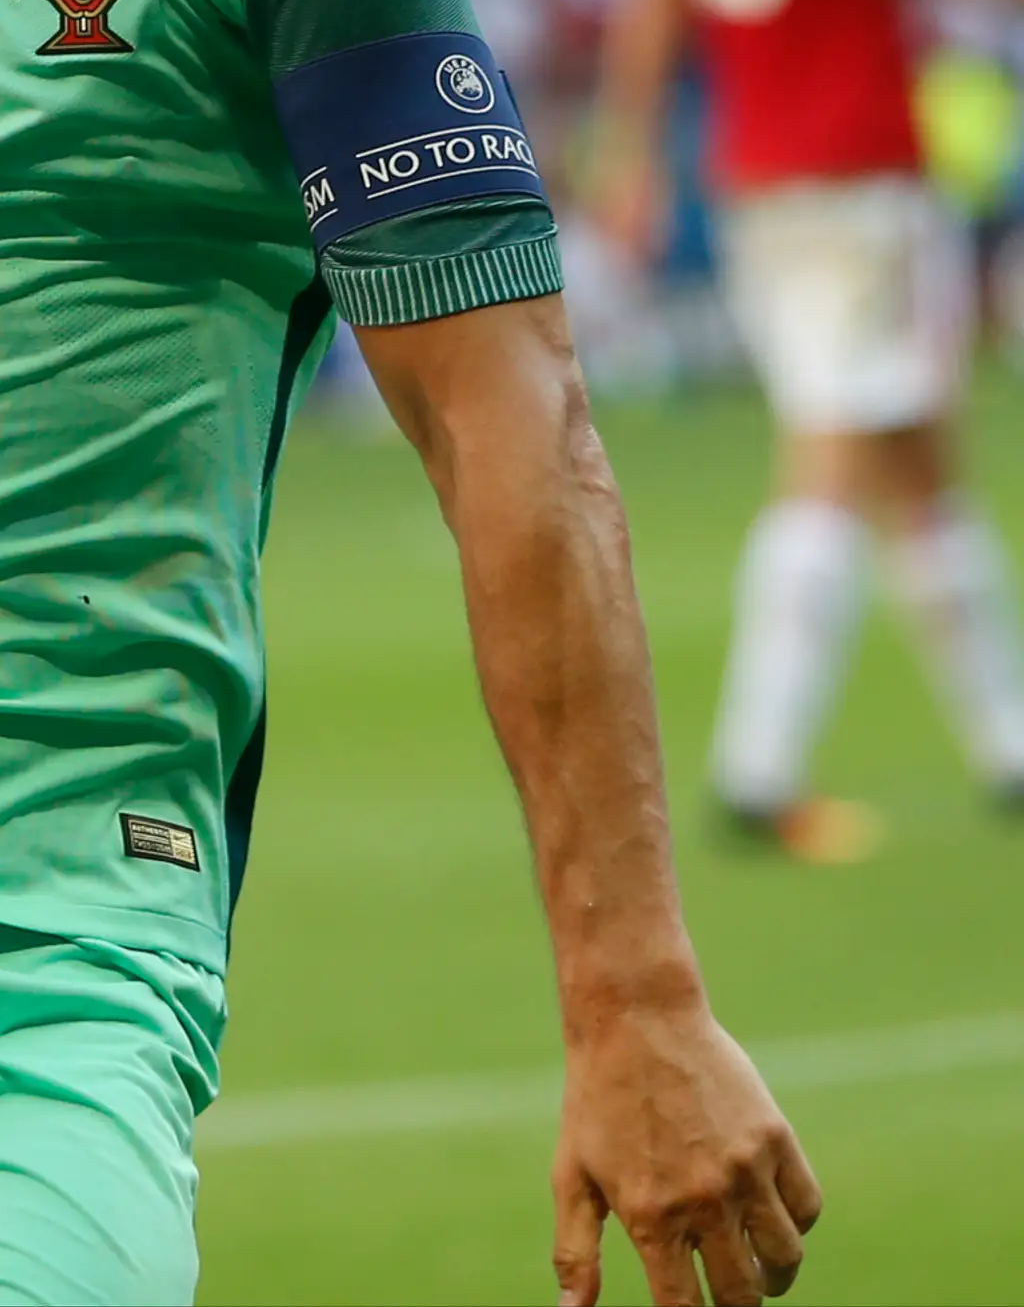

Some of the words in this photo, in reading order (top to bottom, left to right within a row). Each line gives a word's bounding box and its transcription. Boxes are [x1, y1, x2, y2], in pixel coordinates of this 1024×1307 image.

[443, 59, 476, 74] UEFA
[360, 150, 420, 189] NO
[424, 137, 476, 168] TO
